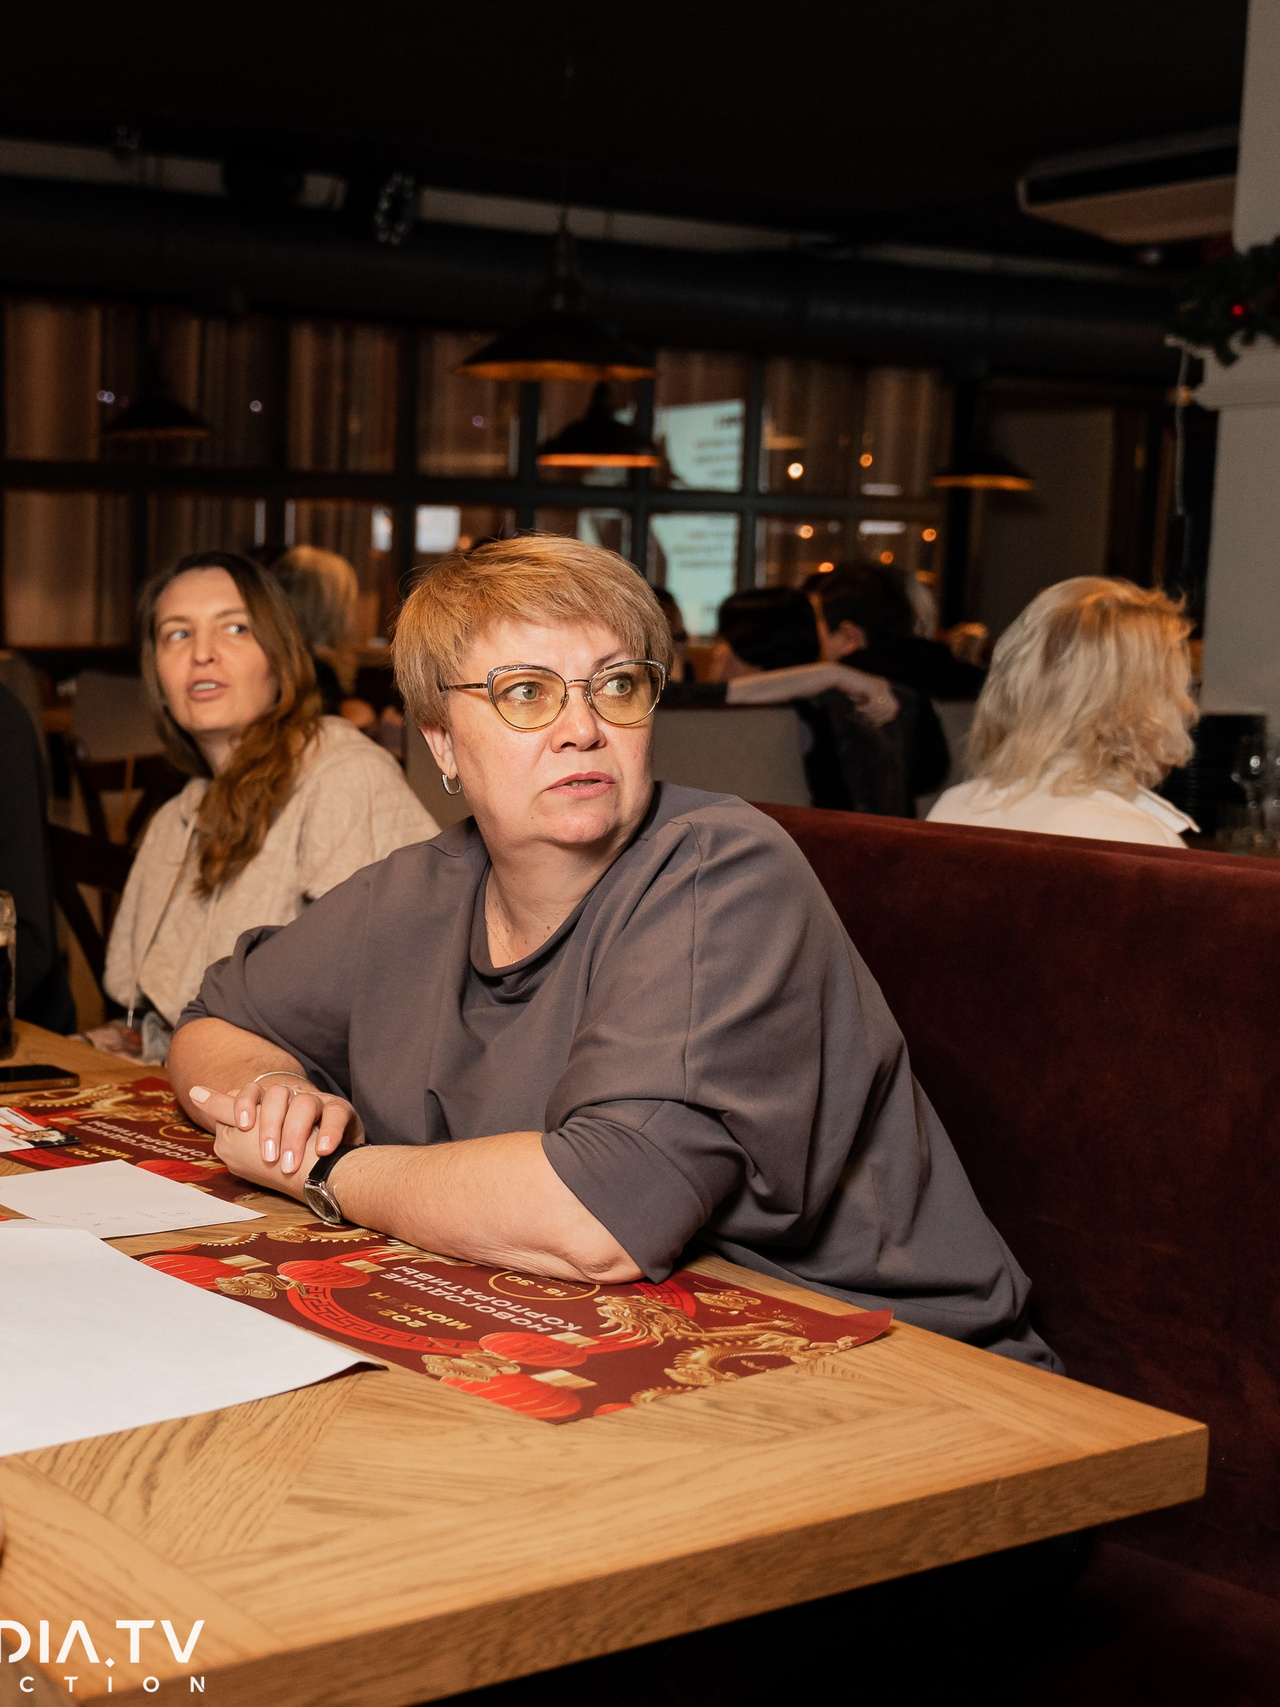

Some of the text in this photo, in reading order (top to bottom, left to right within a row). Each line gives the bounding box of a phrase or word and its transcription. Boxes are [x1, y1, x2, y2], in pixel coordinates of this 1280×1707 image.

[75, 1124, 196, 1162] НОВОГОДНИЕ
[86, 1120, 218, 1161] КОРПОРАТИВЫ
[368, 1292, 473, 1331] МЮНХЕН
[379, 1272, 552, 1333] НОВОГОДНИЕ
[392, 1265, 583, 1332] КОРПОРАТИВЫ
